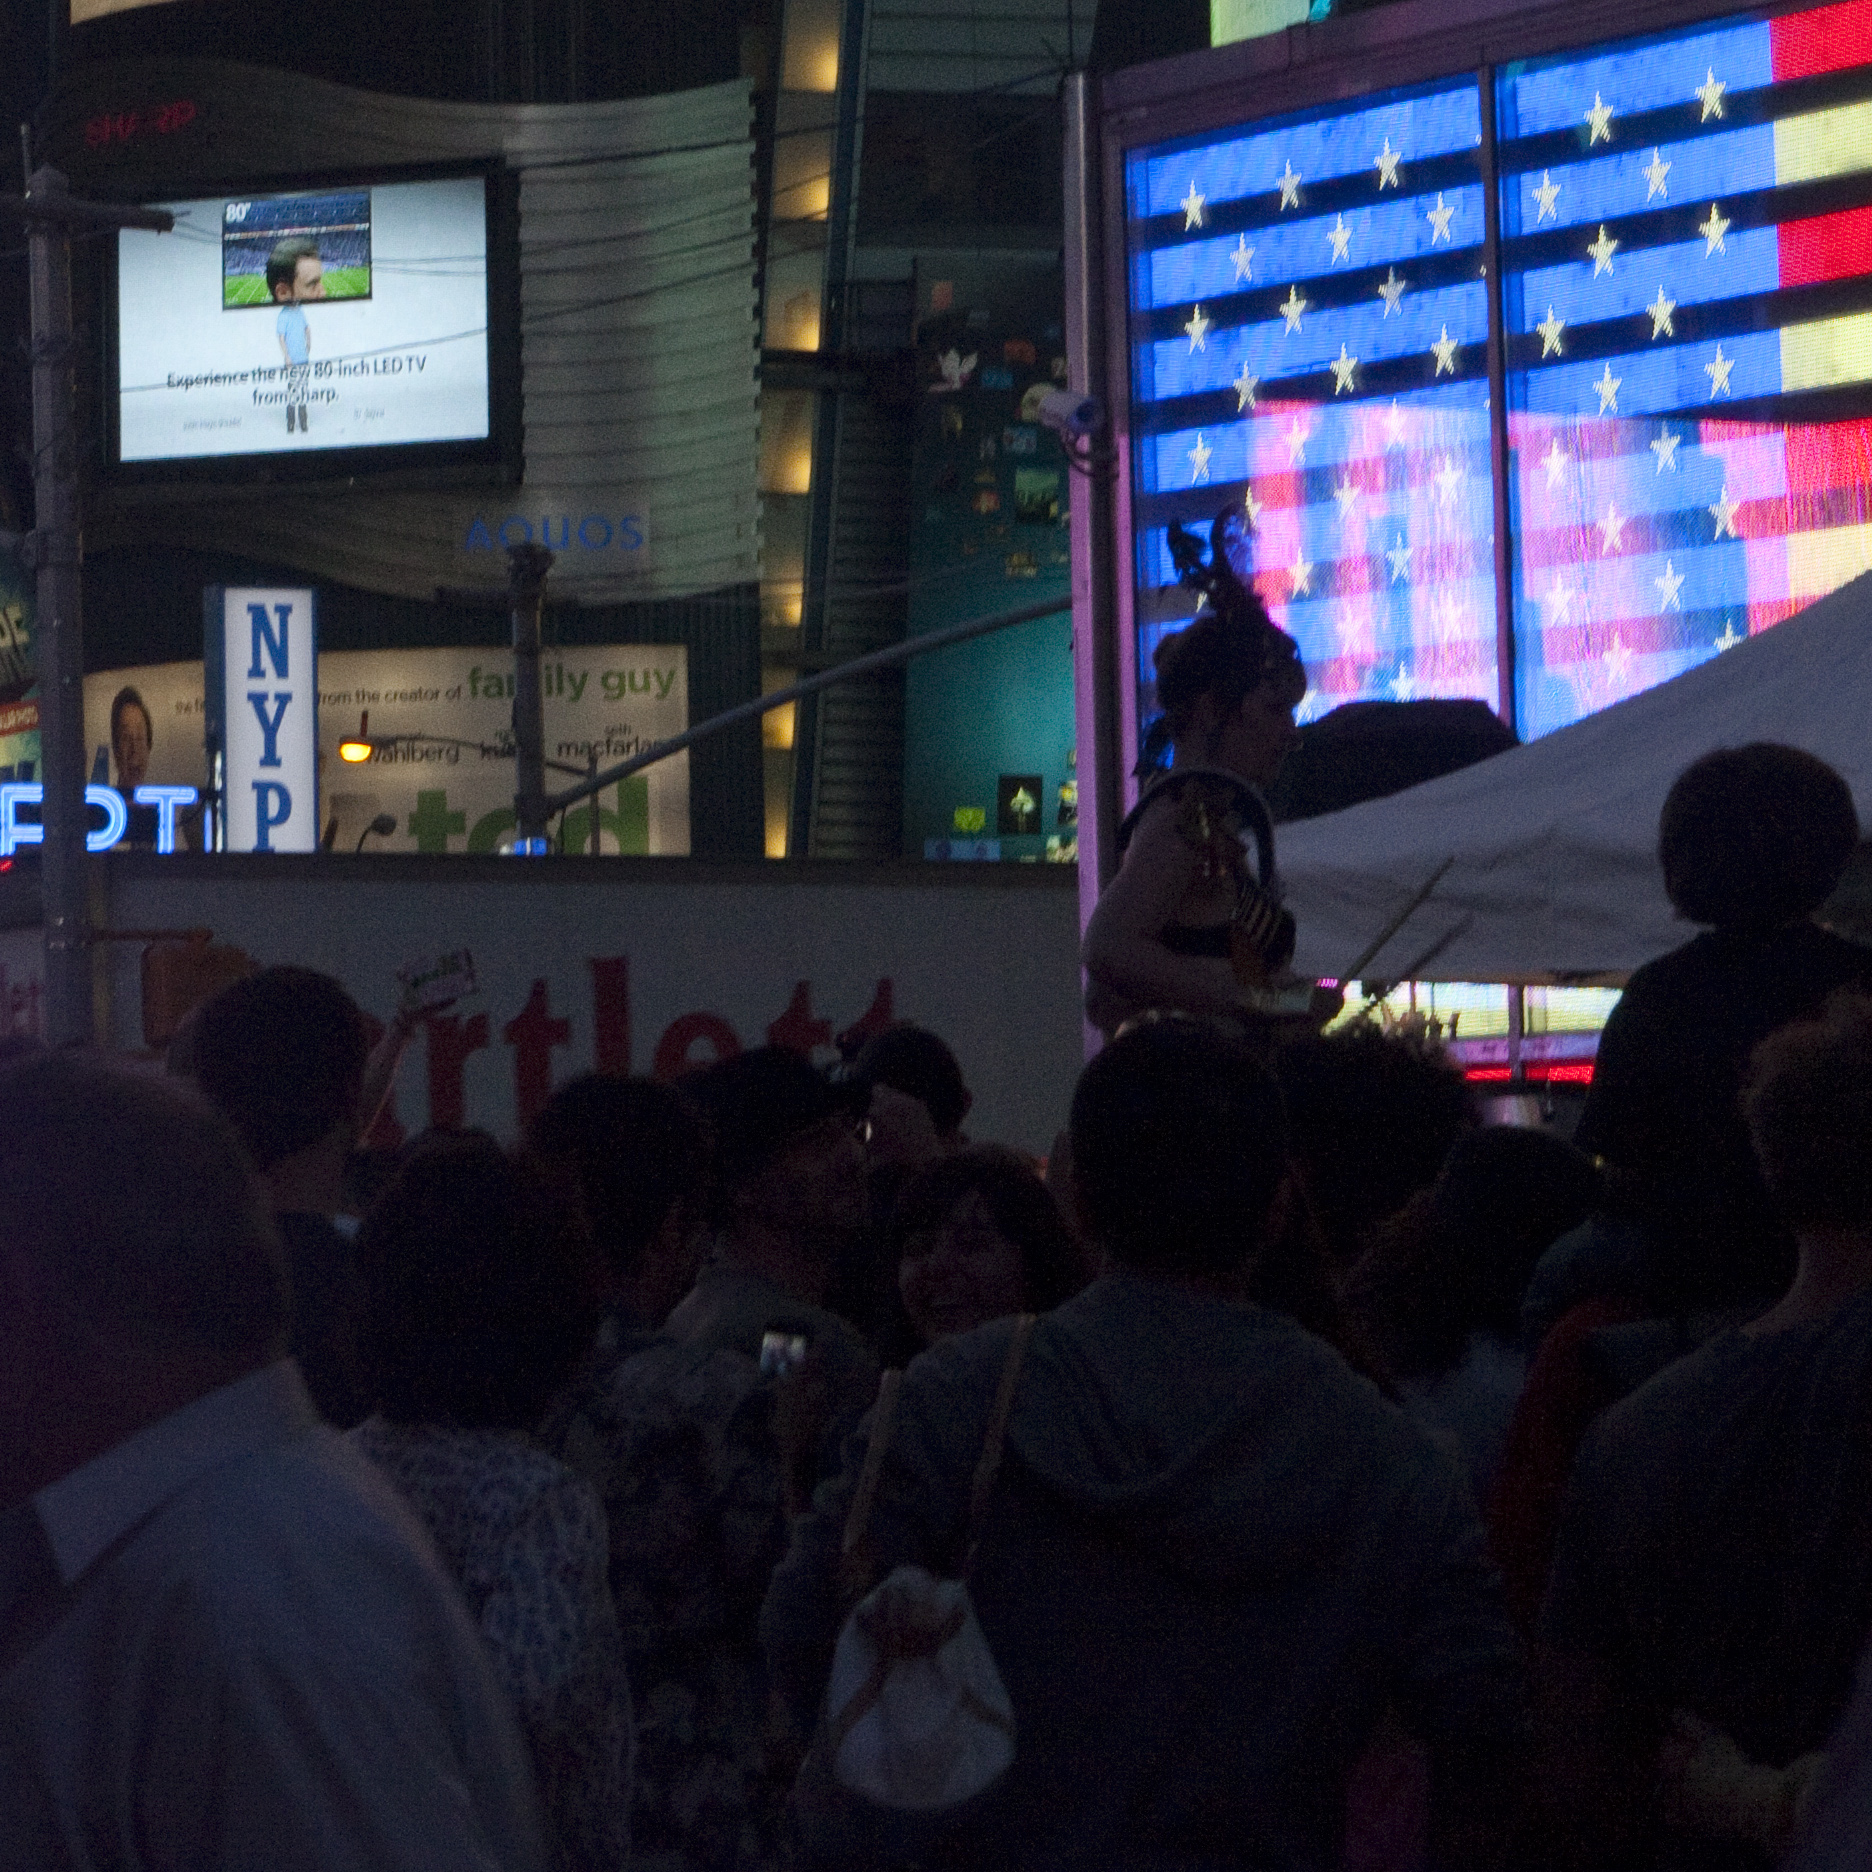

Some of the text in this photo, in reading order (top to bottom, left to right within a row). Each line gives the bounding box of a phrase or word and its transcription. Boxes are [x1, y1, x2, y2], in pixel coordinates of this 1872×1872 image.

[167, 366, 249, 391] Experience
[252, 365, 276, 381] the
[280, 364, 311, 380] new
[374, 358, 403, 374] LED
[405, 355, 428, 374] TV
[252, 388, 287, 407] from
[356, 688, 380, 705] the
[385, 687, 440, 705] creator
[600, 668, 679, 702] guy
